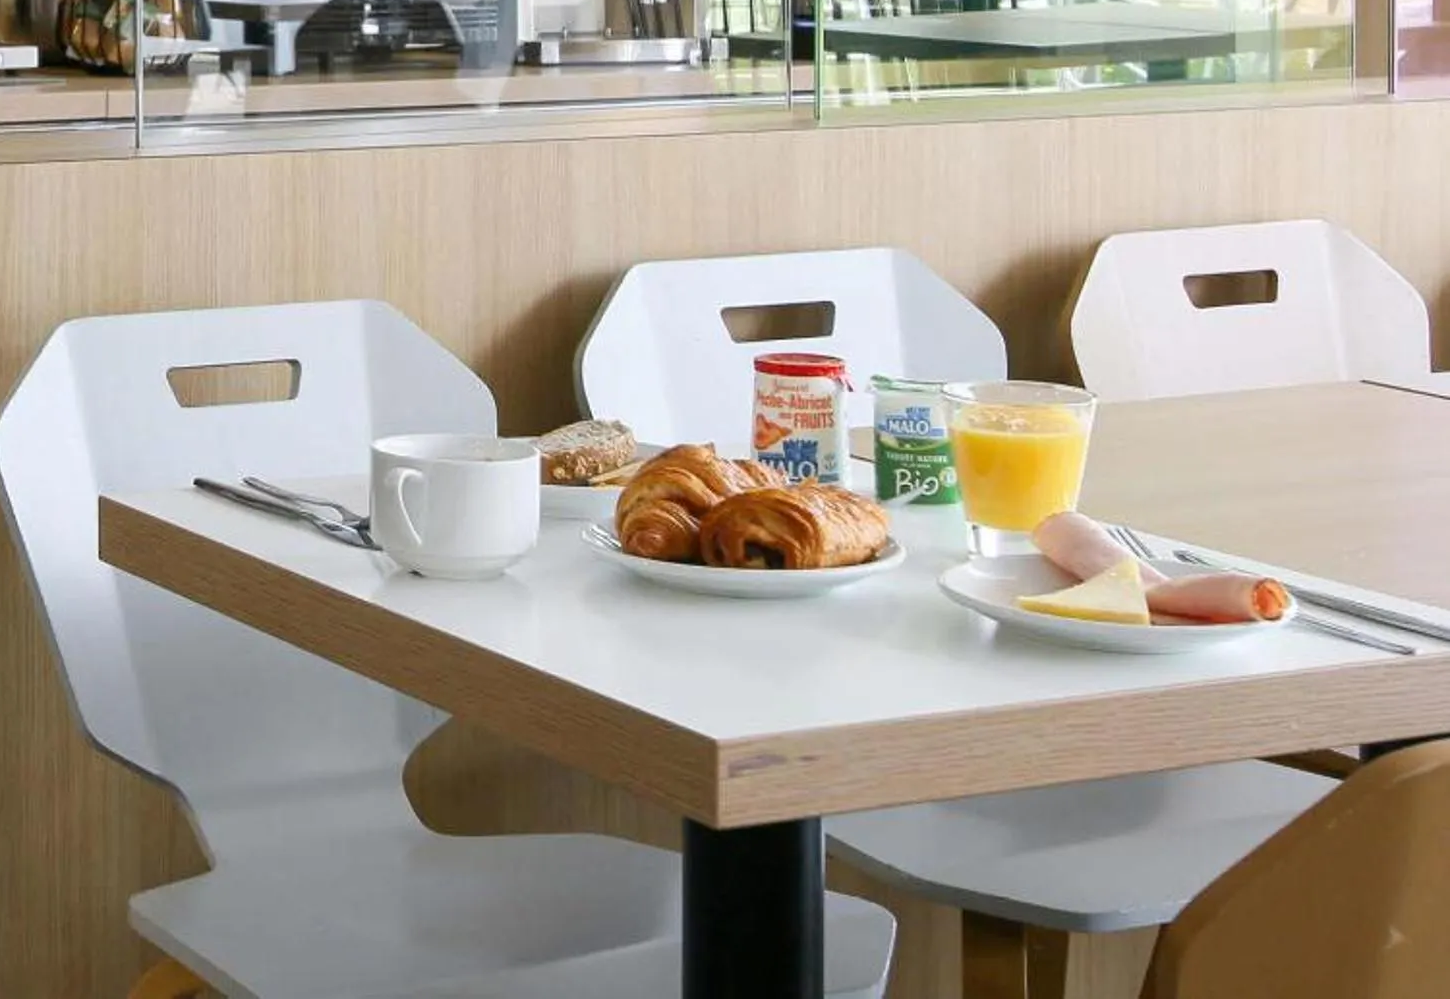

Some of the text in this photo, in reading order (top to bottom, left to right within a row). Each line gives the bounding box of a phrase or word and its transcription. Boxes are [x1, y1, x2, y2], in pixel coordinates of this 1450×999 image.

[794, 412, 835, 429] FRUITS
[887, 418, 930, 434] MALO
[894, 468, 939, 496] Bio
